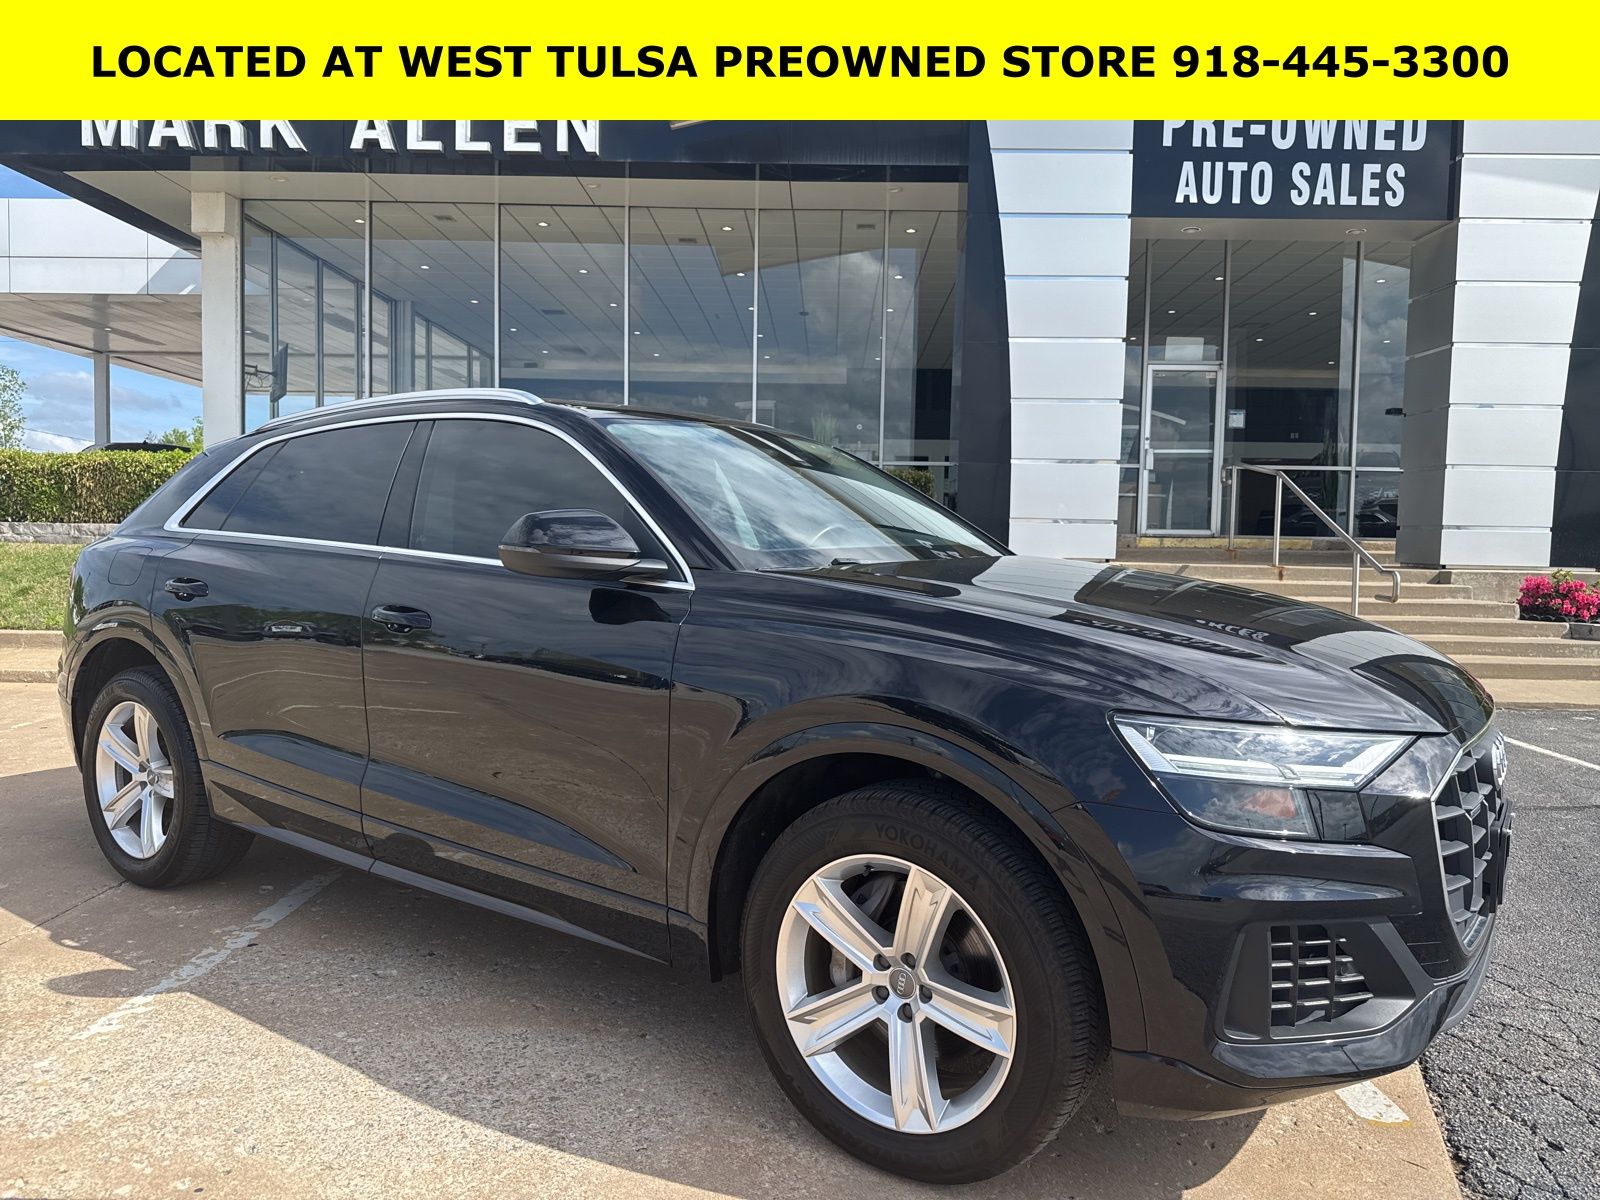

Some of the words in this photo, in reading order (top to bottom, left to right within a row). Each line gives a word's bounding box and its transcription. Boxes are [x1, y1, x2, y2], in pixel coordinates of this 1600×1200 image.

[1162, 120, 1427, 151] PRE-OWNED
[1175, 161, 1273, 206] AUTO
[1290, 162, 1406, 207] SALES
[873, 822, 981, 892] YOKOHAMA
